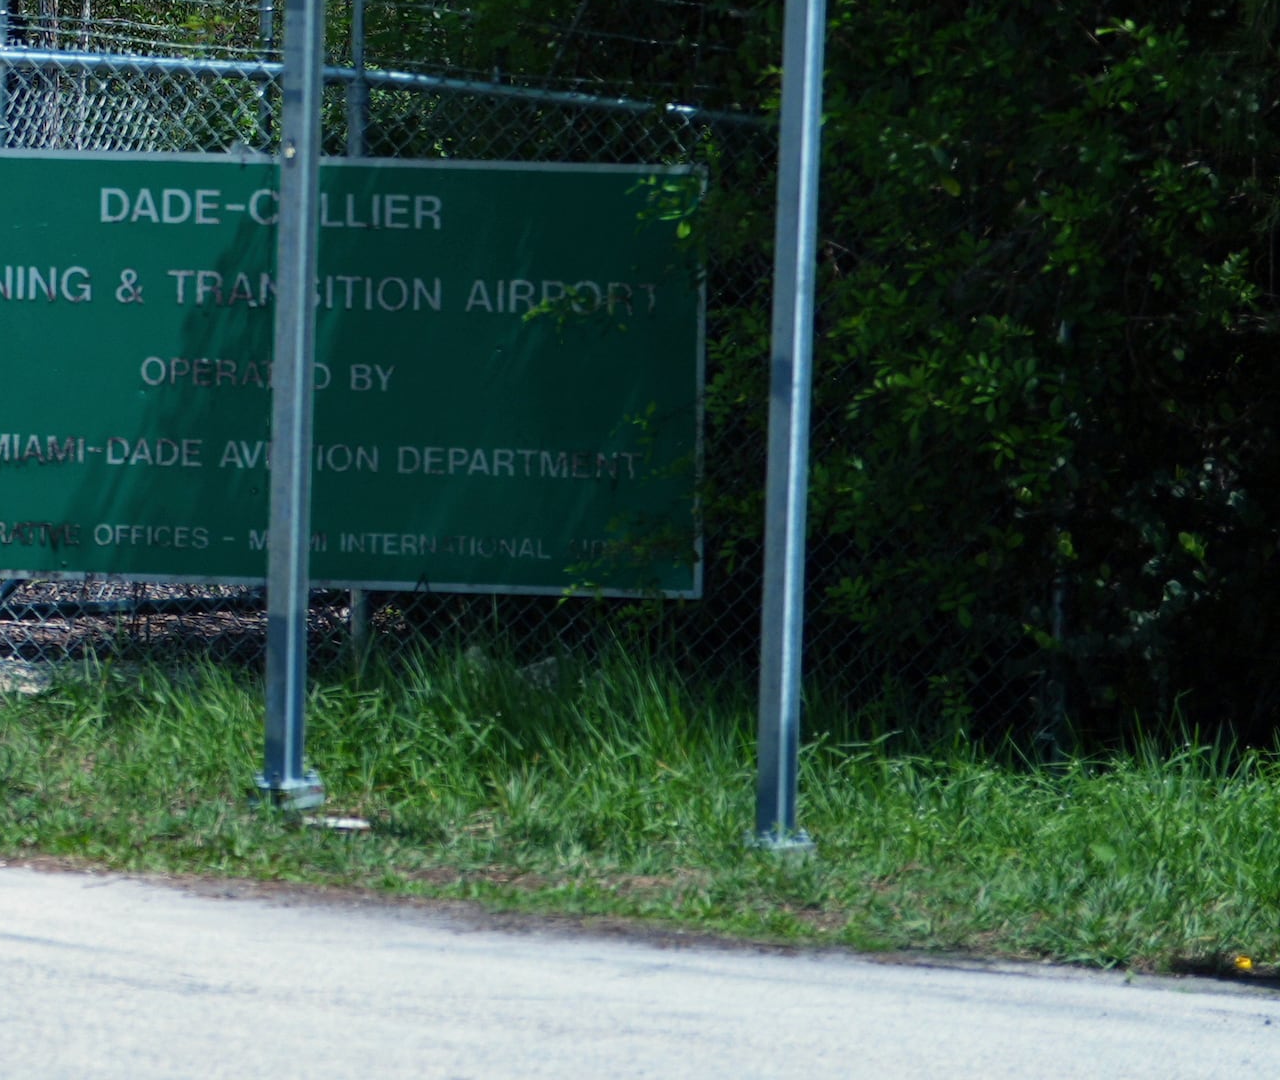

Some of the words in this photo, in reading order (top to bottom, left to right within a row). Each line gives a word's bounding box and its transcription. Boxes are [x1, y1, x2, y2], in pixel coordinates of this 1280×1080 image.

[100, 187, 443, 230] DADE-CLLIER
[115, 268, 144, 305] &
[168, 269, 443, 313] TRANITION
[140, 356, 332, 391] OPERATD
[350, 364, 396, 392] BY
[219, 439, 380, 473] AVIION
[397, 445, 644, 481] DEPARTMENT
[94, 523, 210, 550] OFFICES
[249, 528, 328, 554] MMI
[340, 532, 552, 561] INTERNATIONAL
